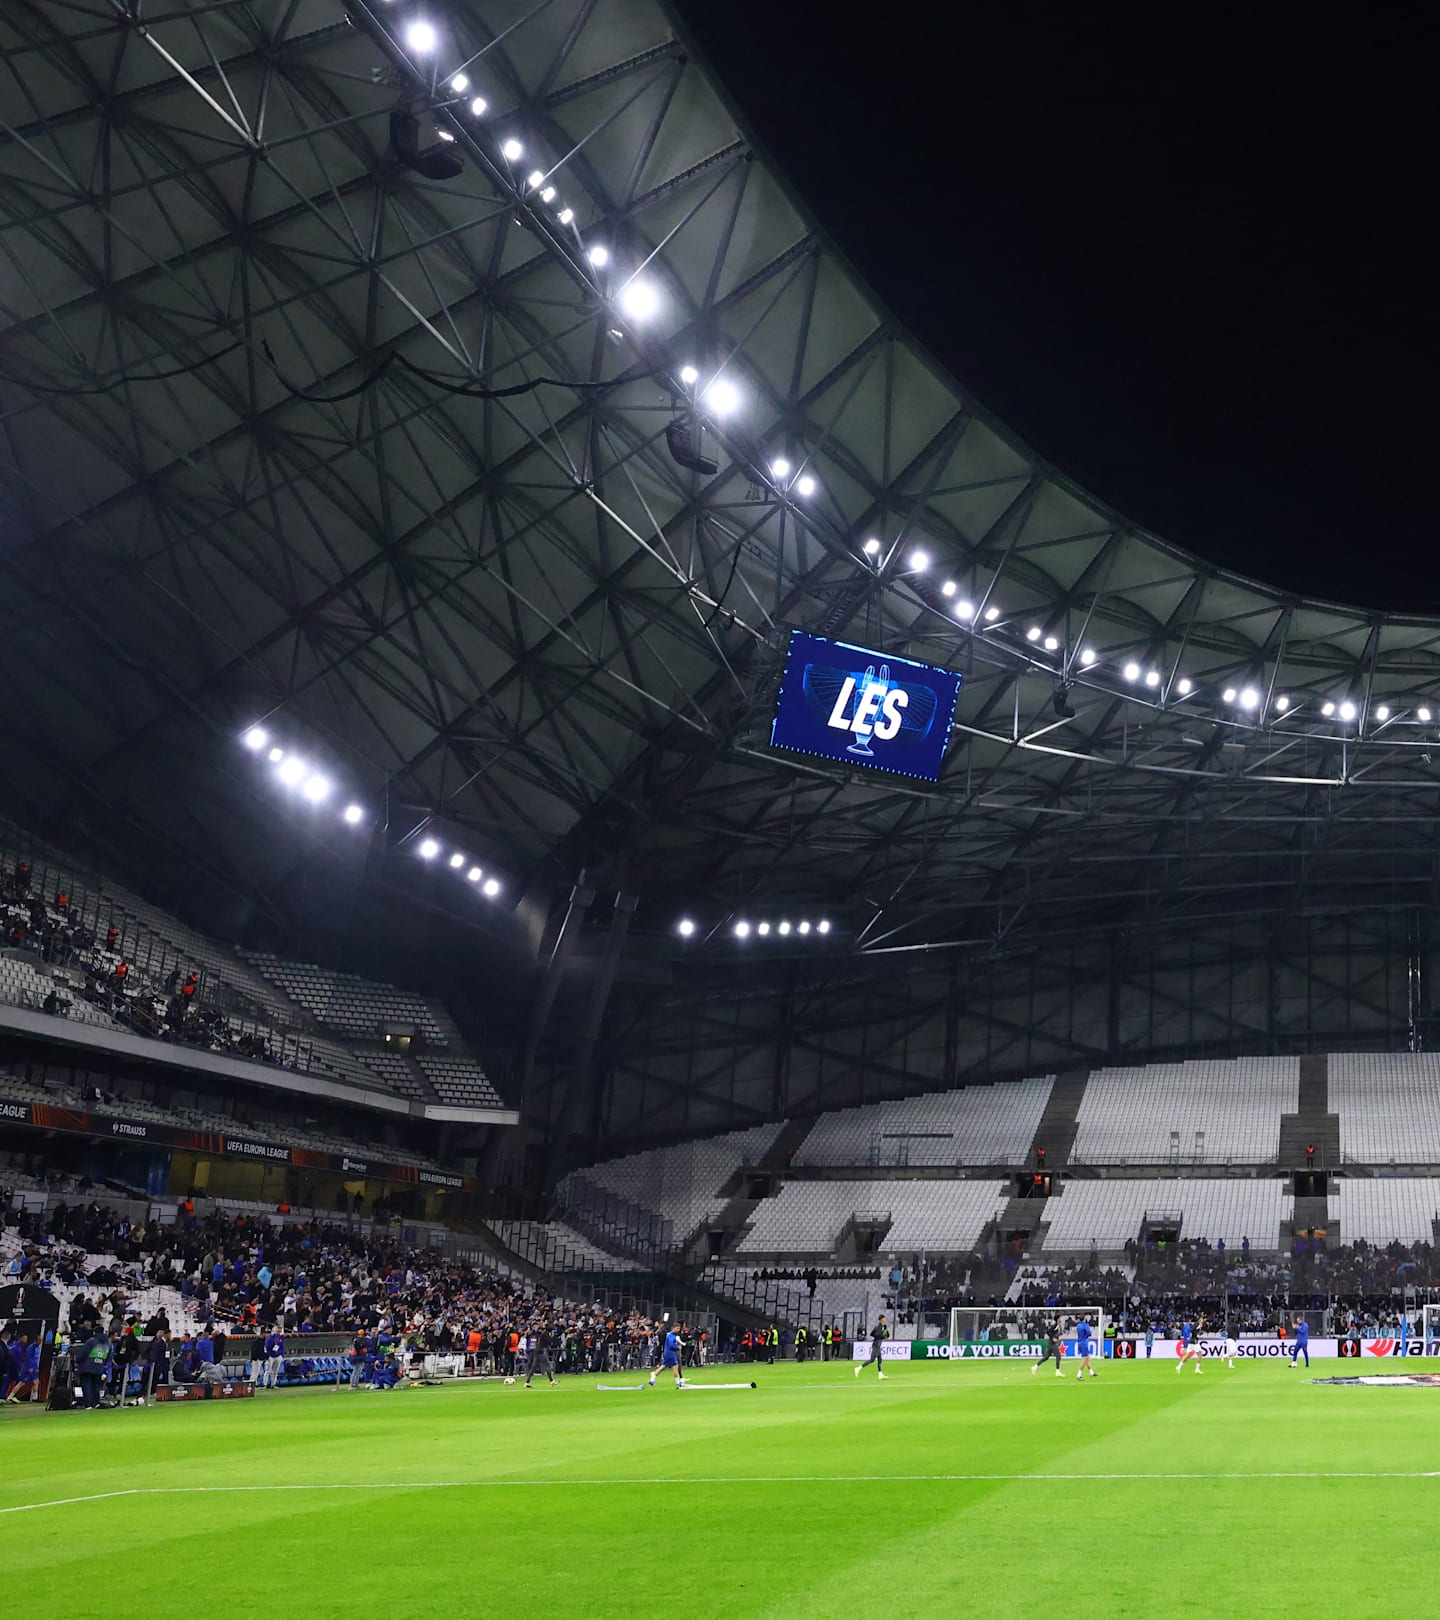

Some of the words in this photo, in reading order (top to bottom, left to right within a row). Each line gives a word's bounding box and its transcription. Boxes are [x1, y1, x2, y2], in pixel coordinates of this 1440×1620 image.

[827, 676, 909, 741] LES
[118, 1123, 147, 1136] STRAUSS
[227, 1140, 243, 1152] UEFA
[243, 1143, 266, 1156] EUROPA
[266, 1146, 289, 1159] LEAGUE
[869, 1346, 909, 1355] SPECT
[926, 1344, 967, 1357] now
[971, 1344, 1005, 1358] you
[1009, 1344, 1043, 1357] can
[1199, 1341, 1296, 1358] Swisquote
